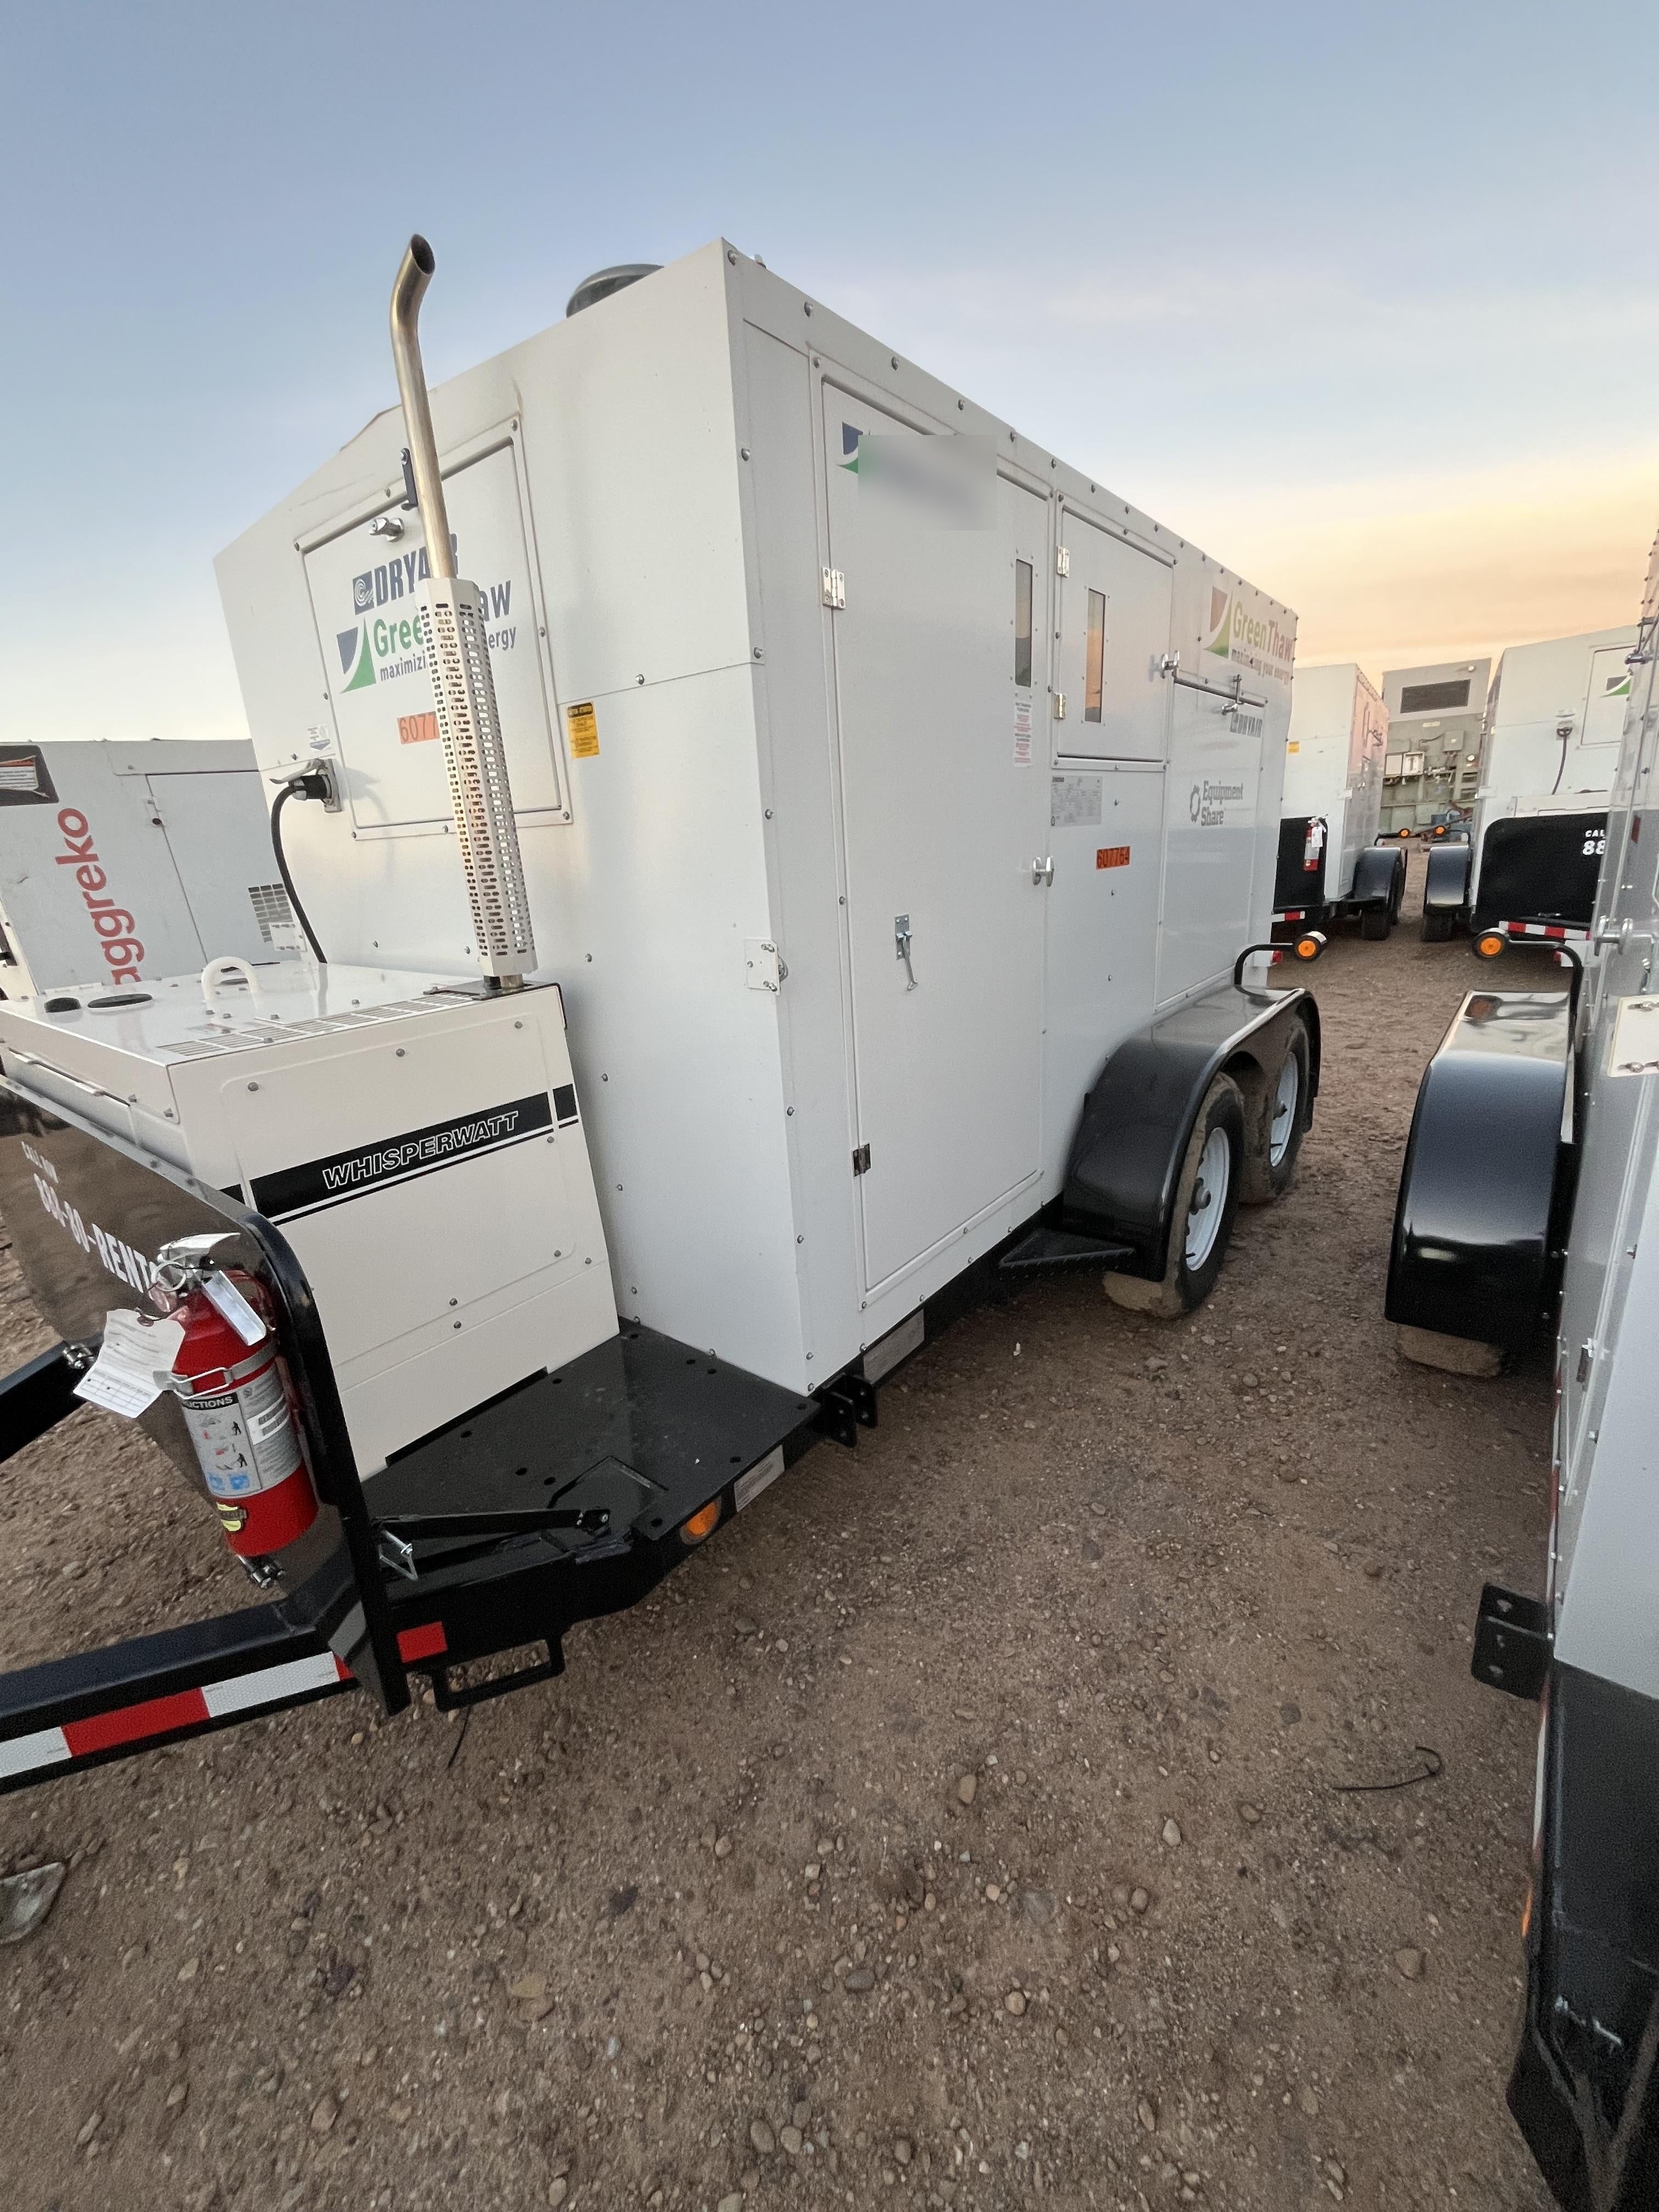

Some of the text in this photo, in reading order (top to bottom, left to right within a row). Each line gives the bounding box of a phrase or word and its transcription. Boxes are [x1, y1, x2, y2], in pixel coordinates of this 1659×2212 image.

[380, 627, 516, 681] maximizi ergy
[400, 712, 436, 742] 6077
[1203, 780, 1243, 805] Equipment
[1201, 806, 1224, 826] Share
[1585, 829, 1605, 838] CAL
[323, 1111, 518, 1189] WHISPERWATT
